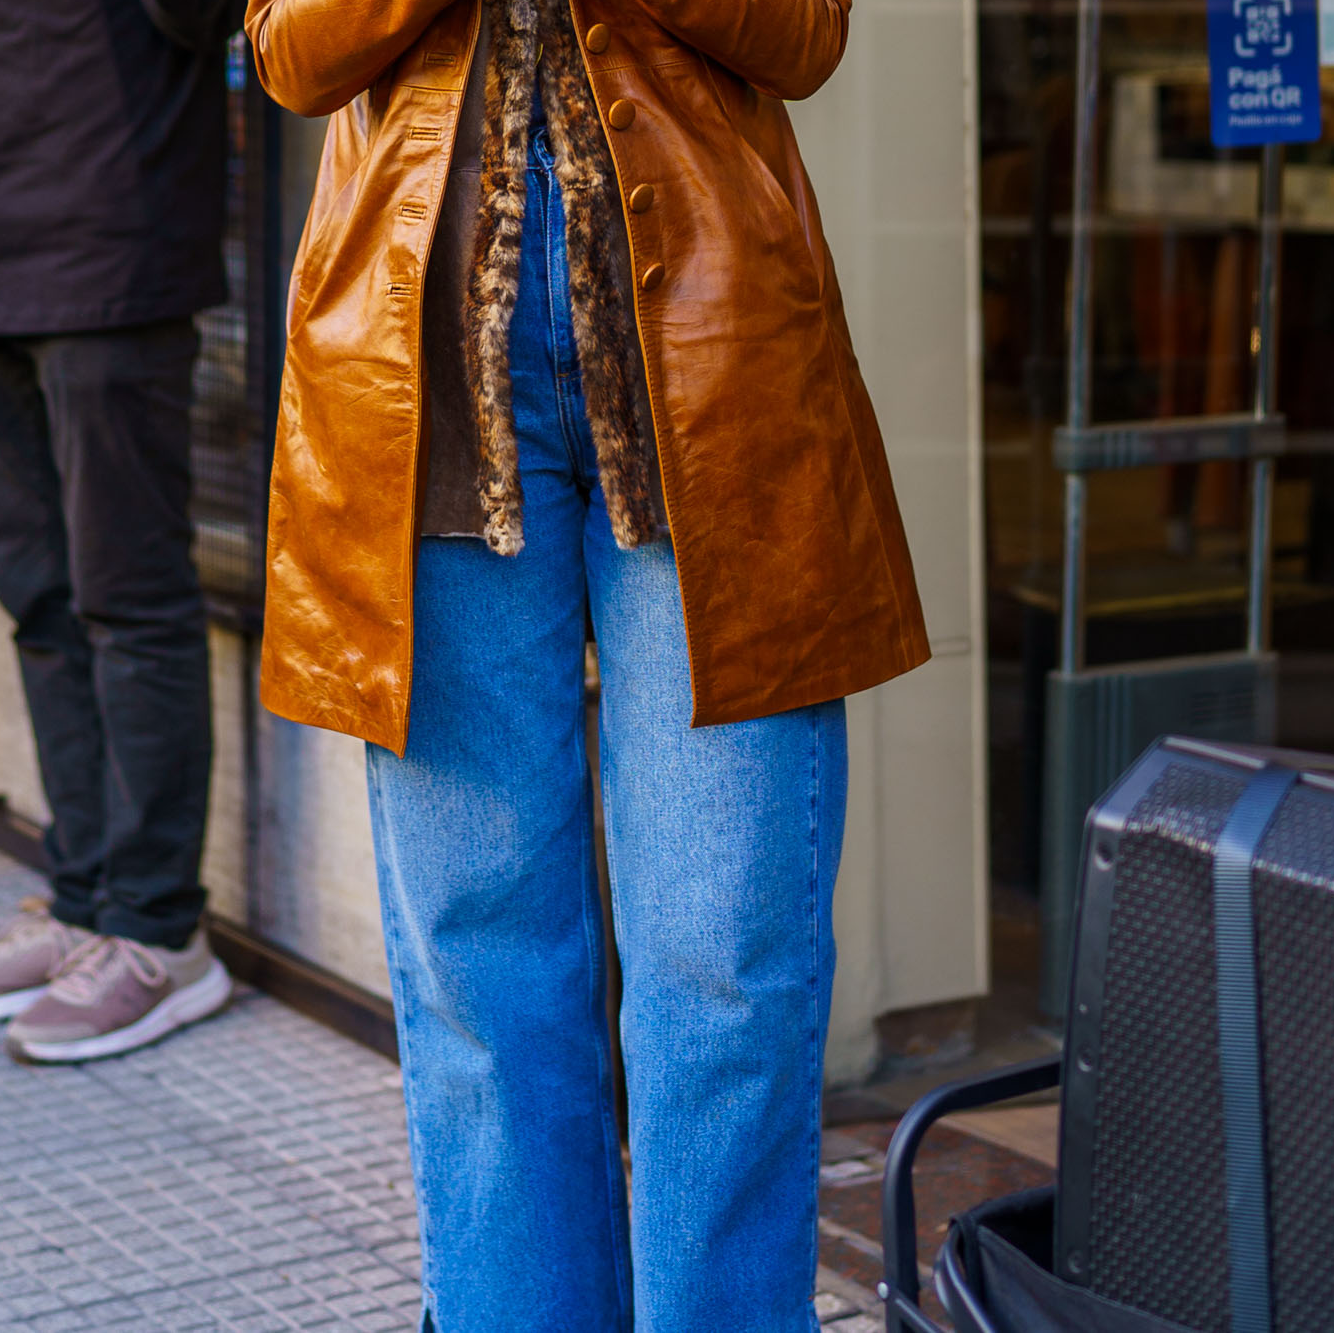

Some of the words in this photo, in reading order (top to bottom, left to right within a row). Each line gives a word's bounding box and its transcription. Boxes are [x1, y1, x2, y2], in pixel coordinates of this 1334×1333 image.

[1228, 63, 1282, 90] Pagá
[1228, 91, 1269, 110] con
[1270, 86, 1302, 109] QR
